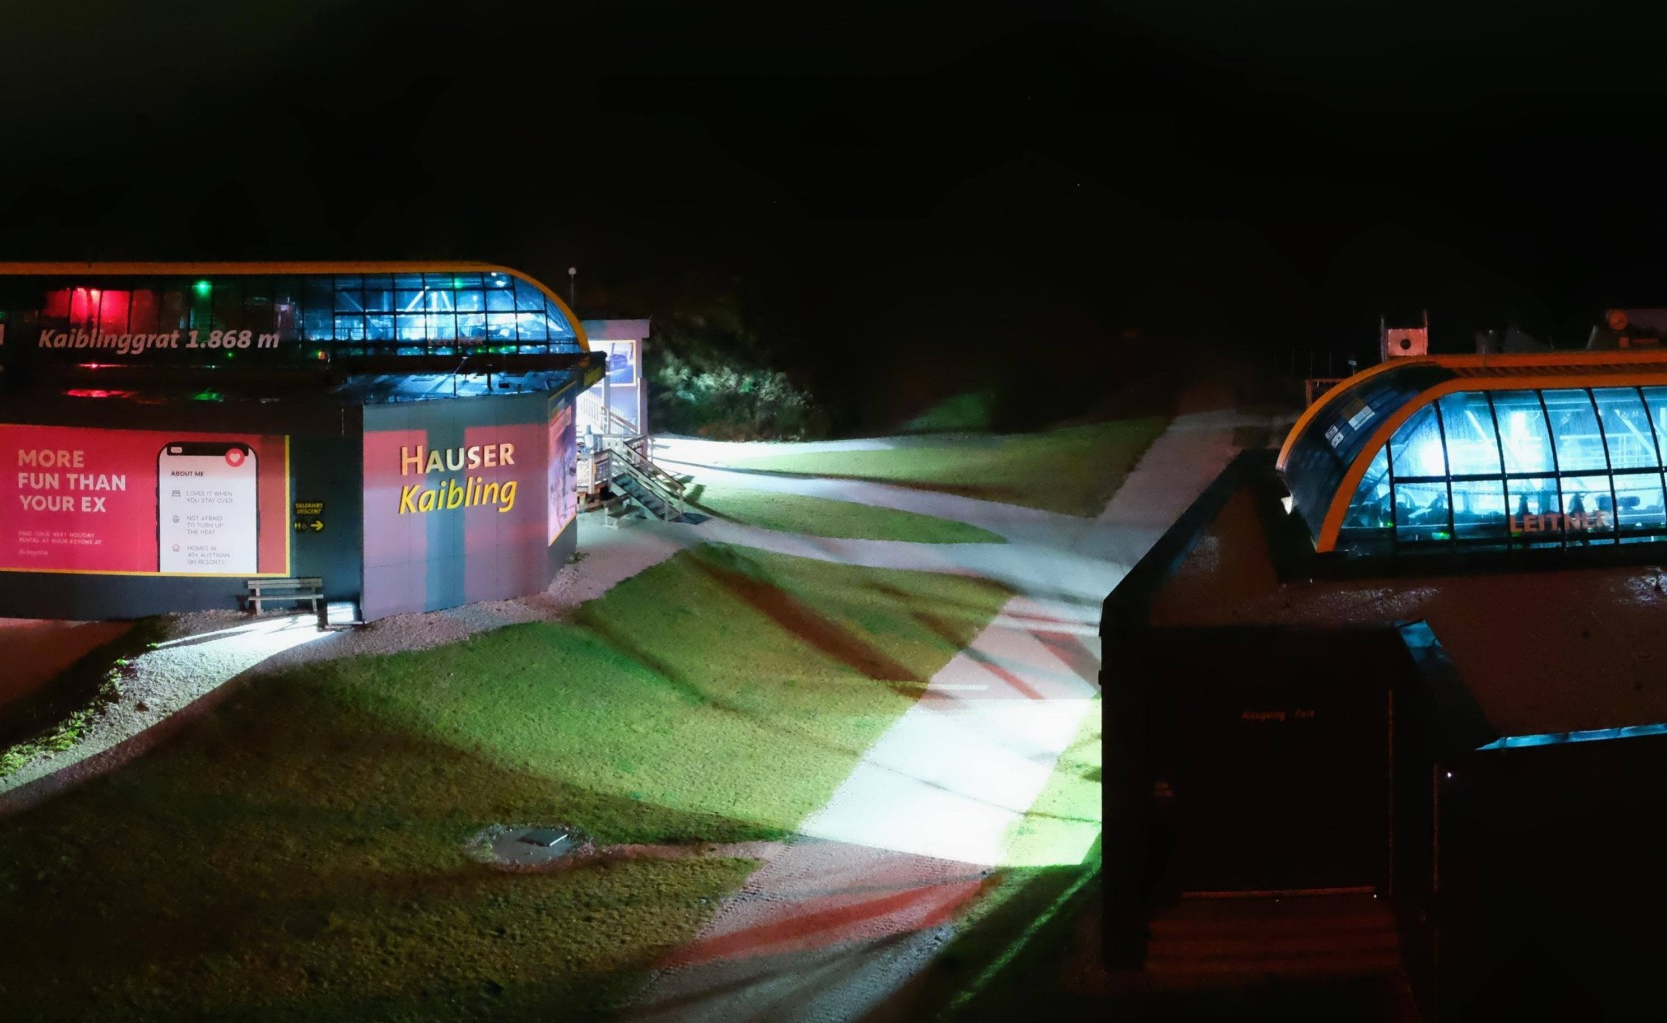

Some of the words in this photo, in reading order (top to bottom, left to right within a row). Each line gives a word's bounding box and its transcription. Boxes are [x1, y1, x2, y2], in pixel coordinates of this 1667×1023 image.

[38, 328, 178, 355] Kaiblinggrat
[185, 329, 252, 349] 1.868
[257, 333, 280, 349] m
[18, 449, 85, 468] MORE
[400, 442, 516, 476] HAUSER
[18, 472, 60, 490] FUN
[66, 473, 127, 492] THAN
[19, 494, 75, 512] YOUR
[81, 496, 107, 513] EX
[398, 476, 518, 515] Kaibling
[1509, 510, 1612, 533] LEITNER
